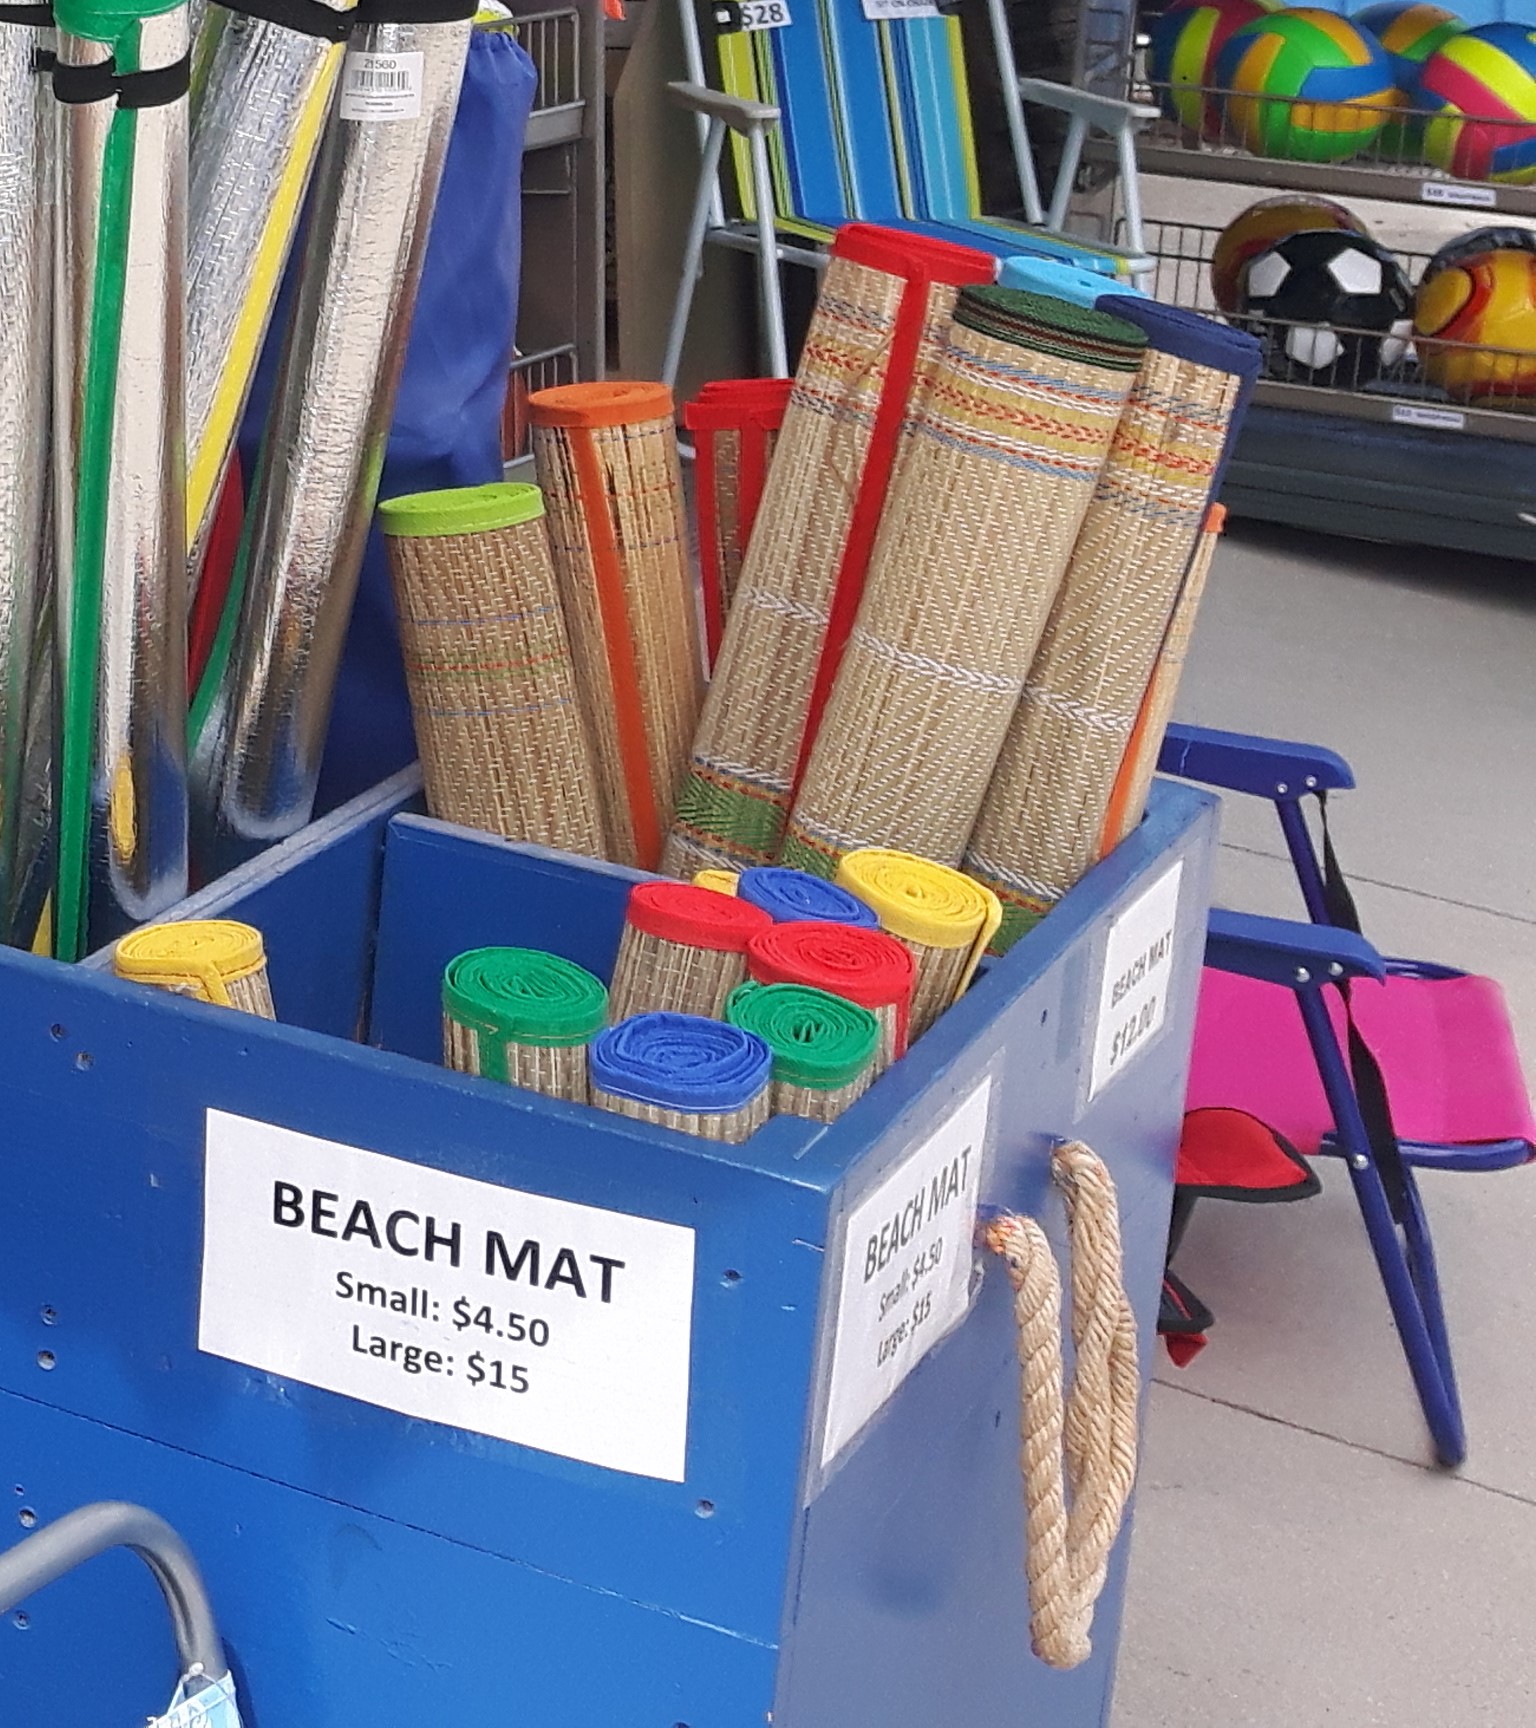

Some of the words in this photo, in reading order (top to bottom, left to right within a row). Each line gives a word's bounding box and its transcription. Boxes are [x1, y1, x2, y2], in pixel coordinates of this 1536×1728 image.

[741, 3, 783, 28] $28
[1111, 951, 1147, 1009] BEACH
[1148, 929, 1172, 972] MAT
[1110, 995, 1157, 1065] $12.00
[273, 1181, 462, 1267] BEACH
[485, 1230, 625, 1304] MAT
[863, 1183, 925, 1284] BEACH
[927, 1147, 973, 1224] MAT
[335, 1272, 439, 1322] Small:
[453, 1296, 550, 1349] $4.50
[877, 1265, 909, 1322] Small:
[909, 1236, 943, 1293] $4.50
[352, 1325, 455, 1377] Large:
[467, 1351, 530, 1394] $15
[876, 1318, 908, 1368] Large:
[909, 1291, 932, 1337] $15
